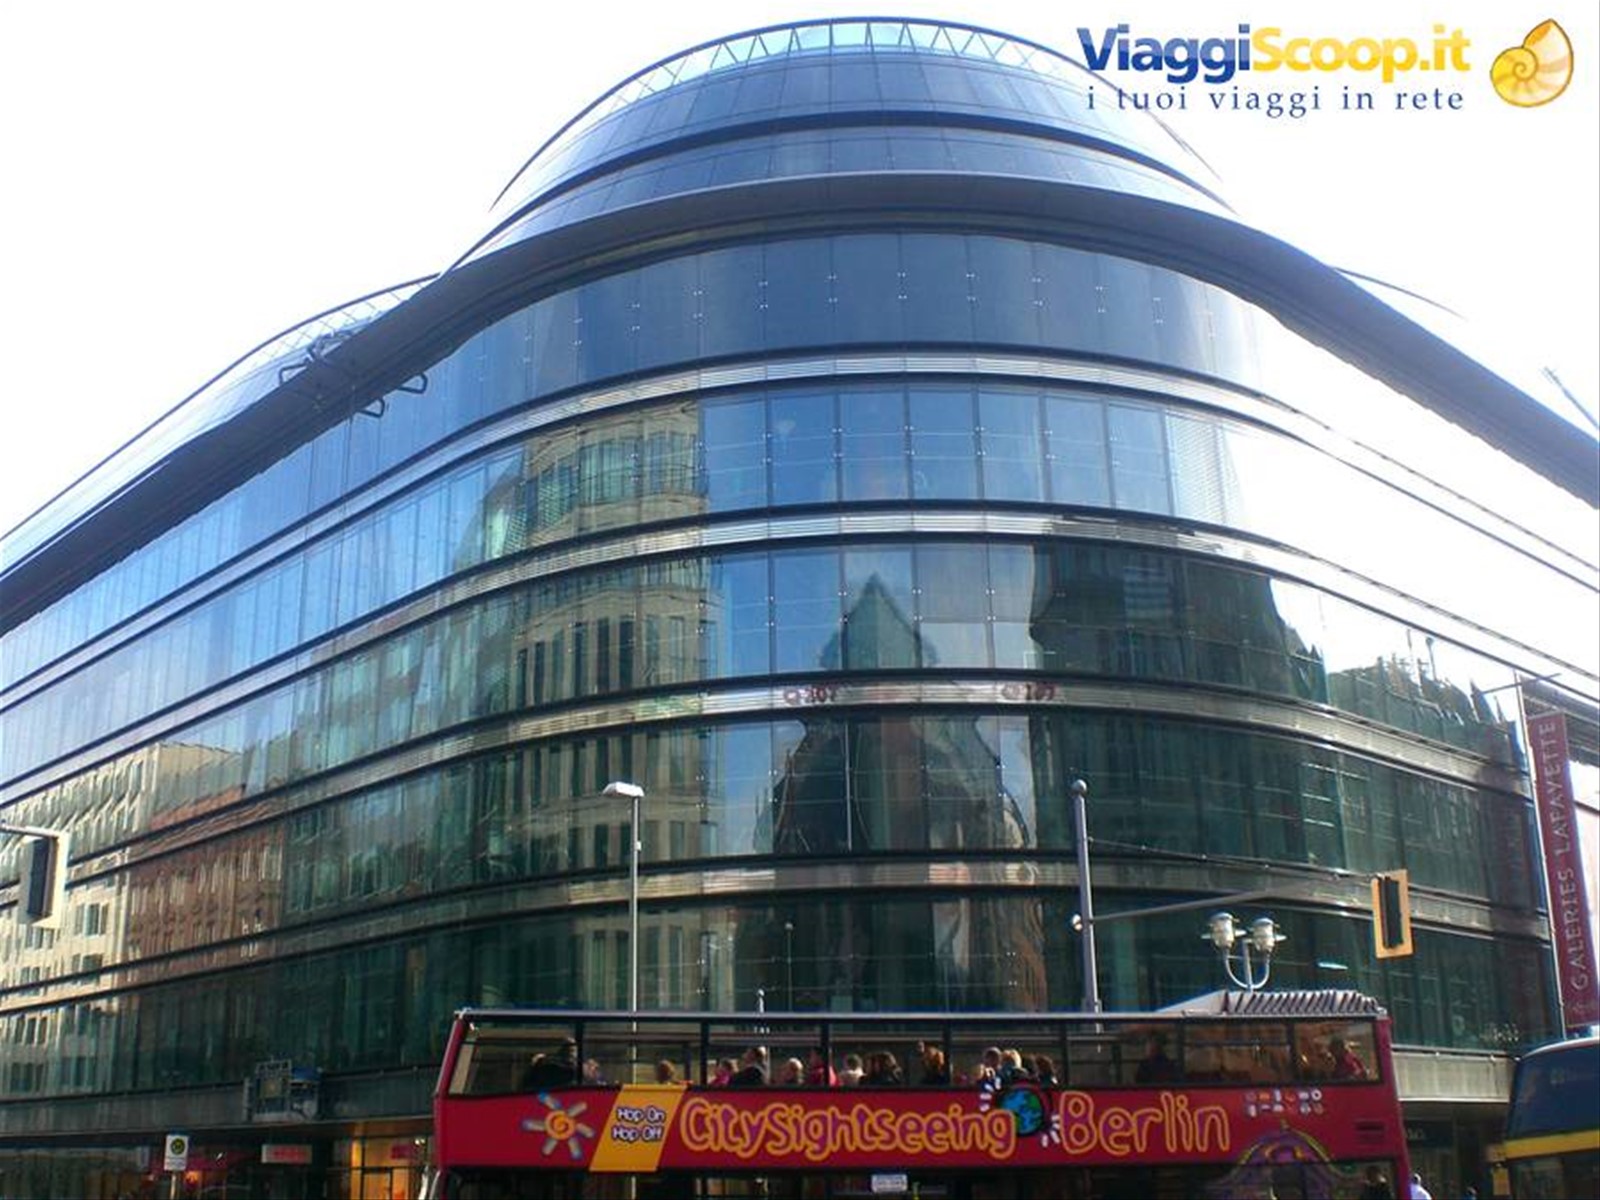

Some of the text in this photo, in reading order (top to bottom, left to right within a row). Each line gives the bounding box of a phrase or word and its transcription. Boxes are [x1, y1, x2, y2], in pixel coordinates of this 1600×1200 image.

[1538, 721, 1588, 991] GALERIES LAFAYETTE
[612, 1125, 663, 1143] Hop Off
[617, 1105, 666, 1123] Hop On
[681, 1090, 1230, 1159] CitySightseeing Berlin
